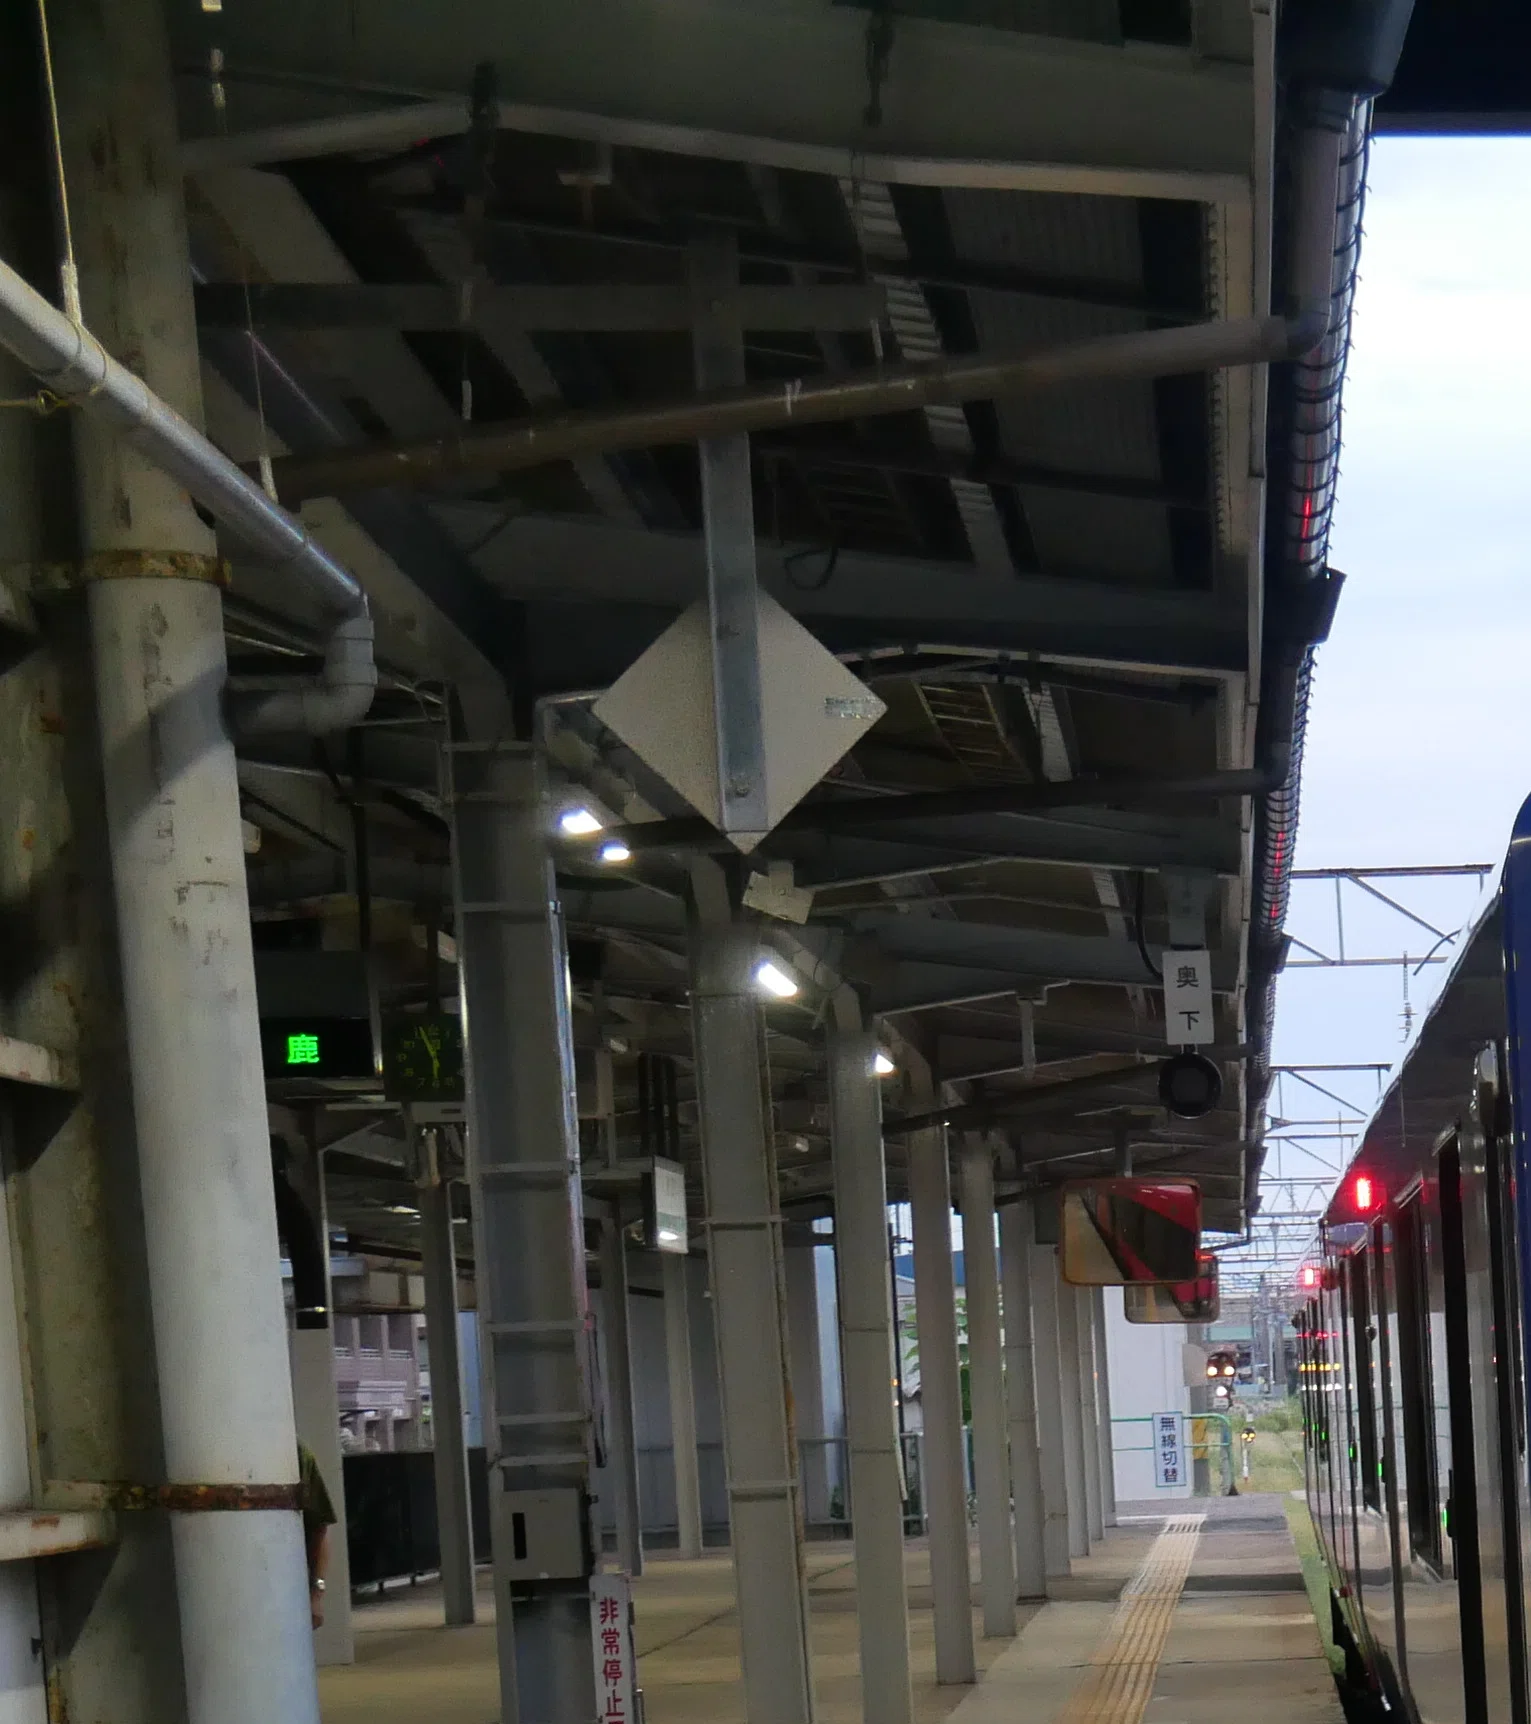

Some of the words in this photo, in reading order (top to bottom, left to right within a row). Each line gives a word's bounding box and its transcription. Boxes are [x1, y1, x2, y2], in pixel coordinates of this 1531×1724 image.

[287, 1034, 320, 1064] 鹿
[1160, 1416, 1178, 1482] 無線切替
